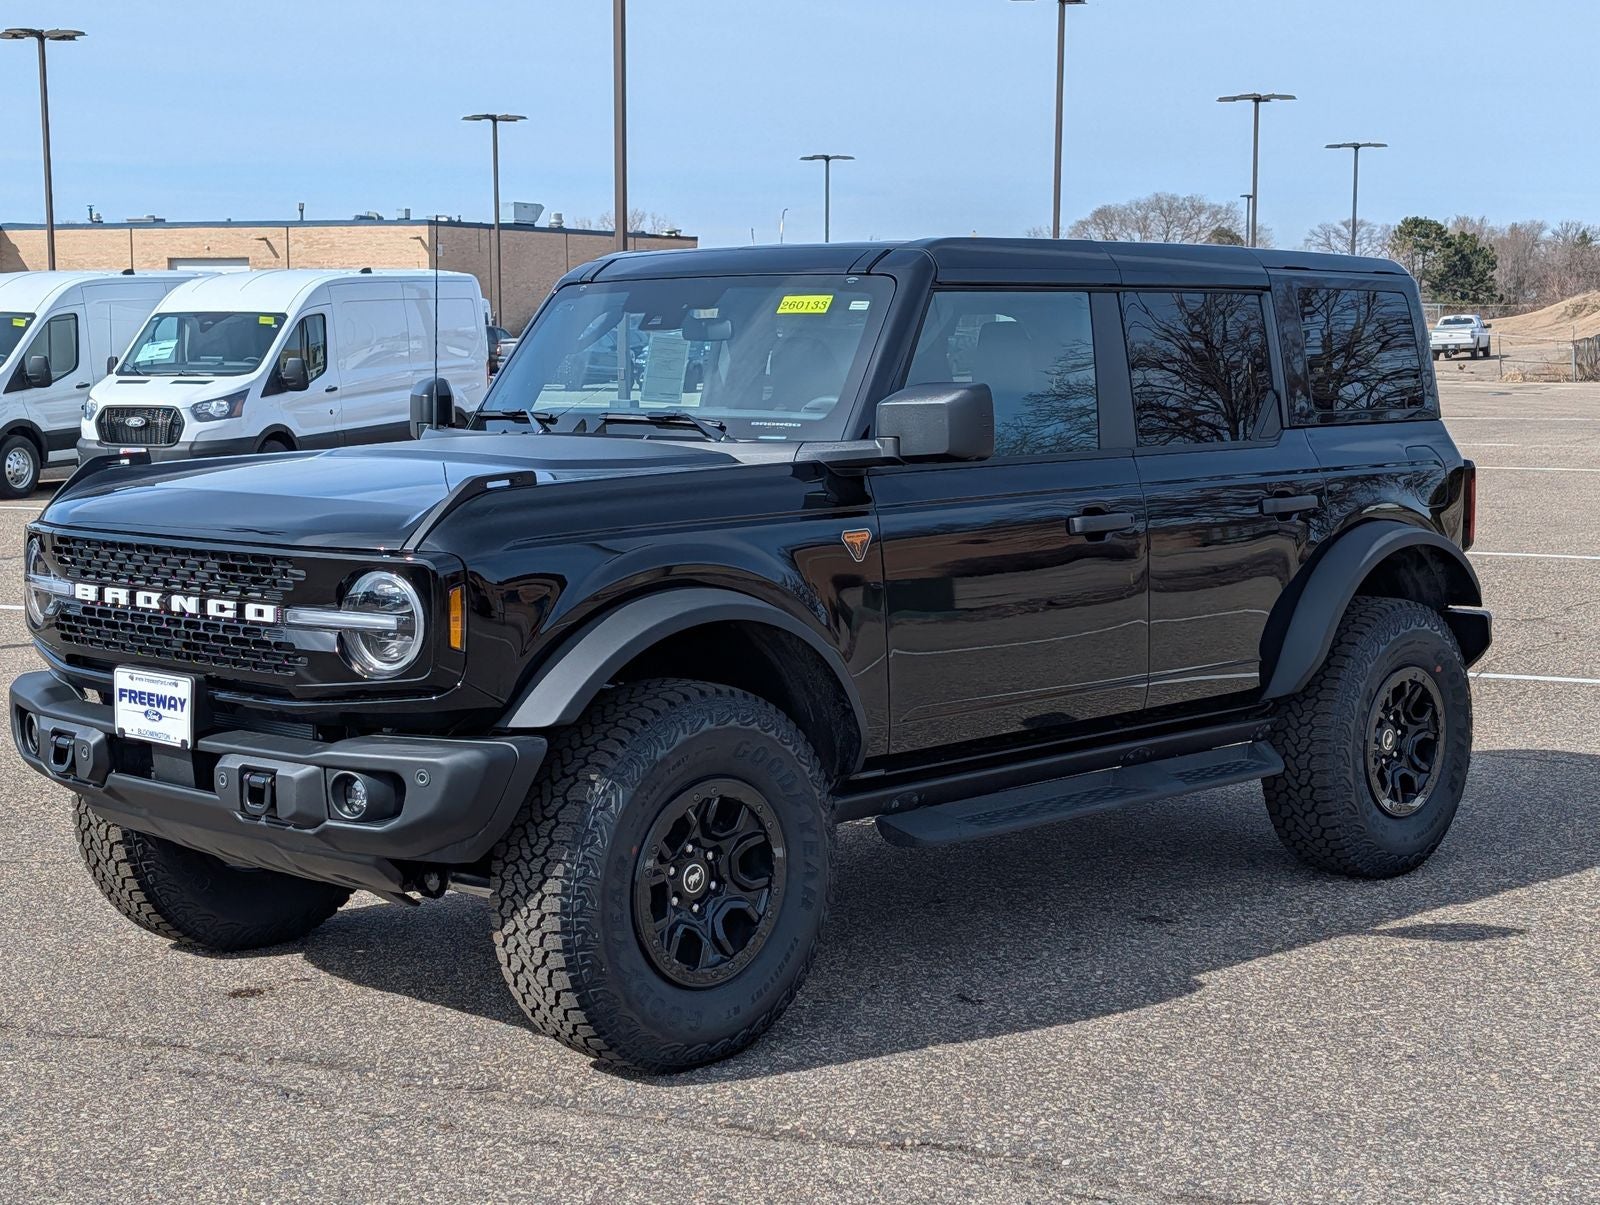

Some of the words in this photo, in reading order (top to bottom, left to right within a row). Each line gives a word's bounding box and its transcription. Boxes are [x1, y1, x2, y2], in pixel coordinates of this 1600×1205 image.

[780, 300, 828, 310] 260133
[74, 583, 278, 623] BRONCO
[118, 687, 187, 713] FREEWAY
[145, 709, 161, 721] Ford
[137, 727, 171, 740] BLOOMINGTON
[733, 740, 819, 912] GOODYEAR
